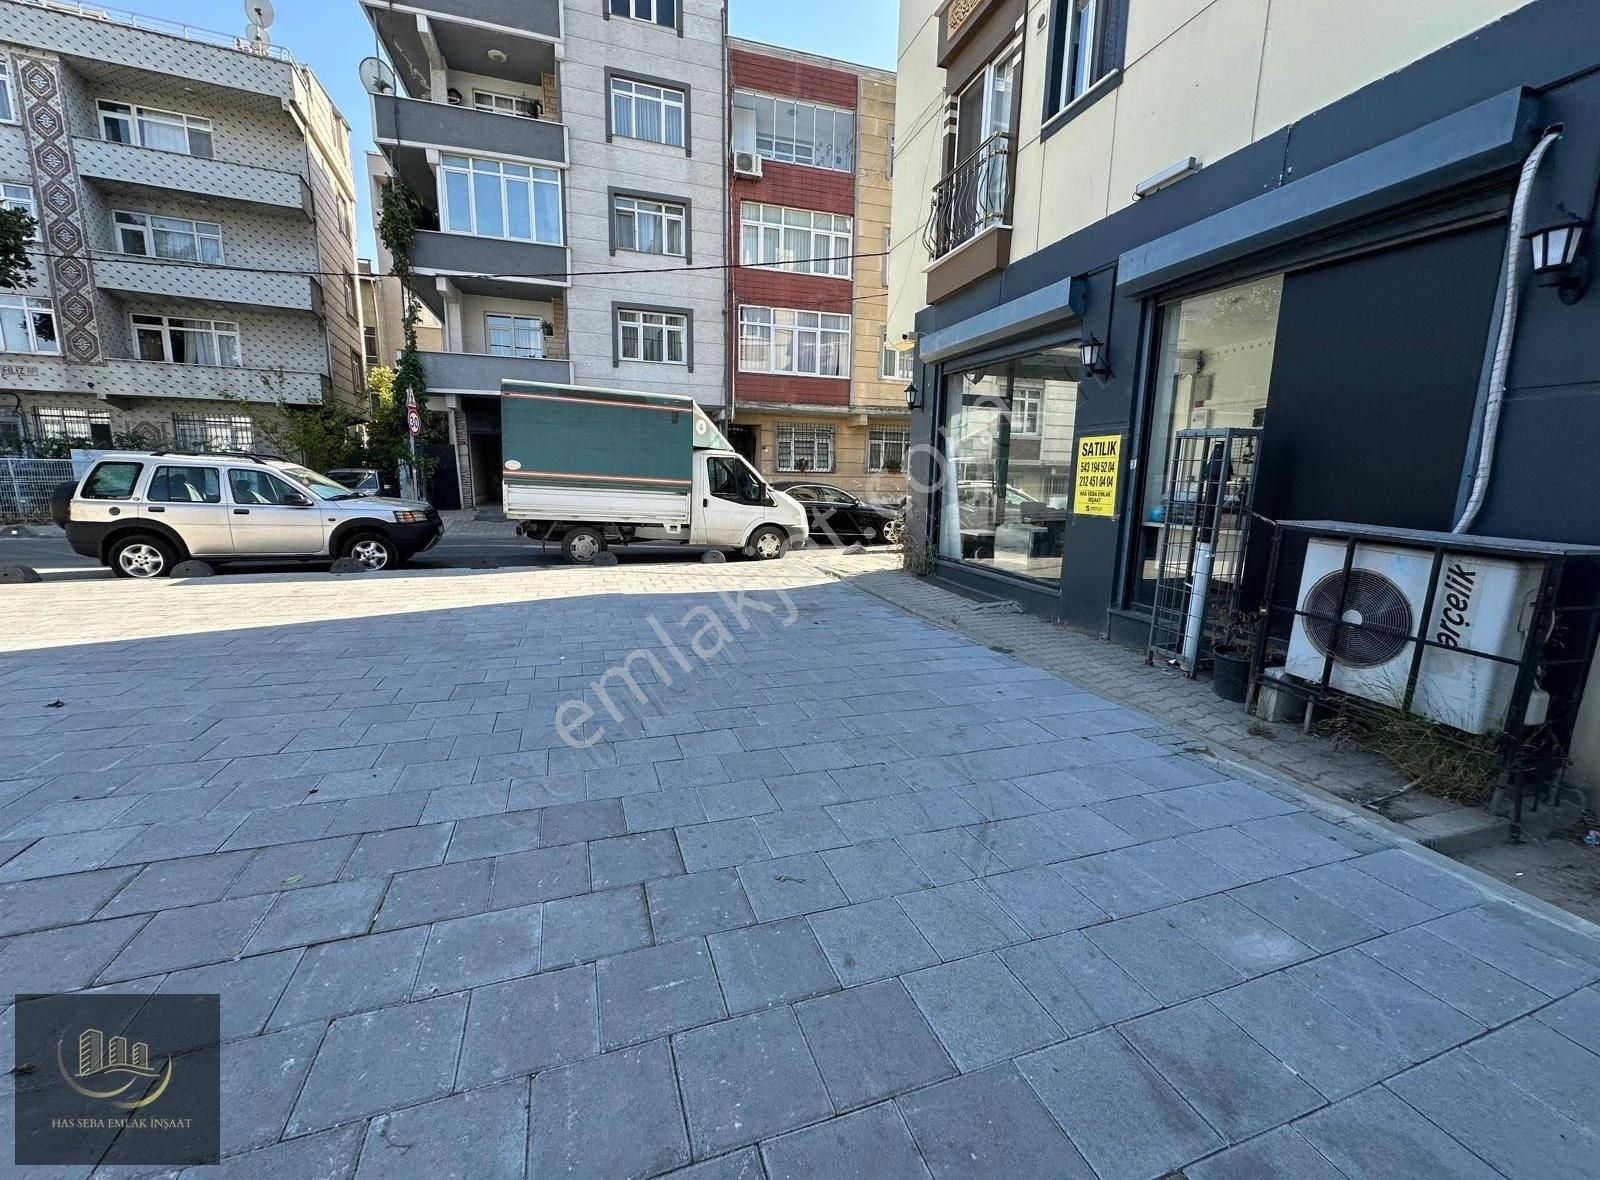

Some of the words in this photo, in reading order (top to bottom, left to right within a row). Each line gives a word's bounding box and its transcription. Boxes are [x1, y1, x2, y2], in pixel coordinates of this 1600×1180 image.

[410, 416, 419, 428] 30
[1082, 441, 1117, 456] SATILIK
[1080, 462, 1090, 473] 543
[1091, 462, 1100, 473] 194
[1100, 462, 1108, 473] 52
[1108, 461, 1115, 473] 04
[1079, 476, 1089, 487] 212
[1089, 476, 1098, 487] 451
[1099, 476, 1106, 487] 04
[1106, 476, 1113, 487] 04
